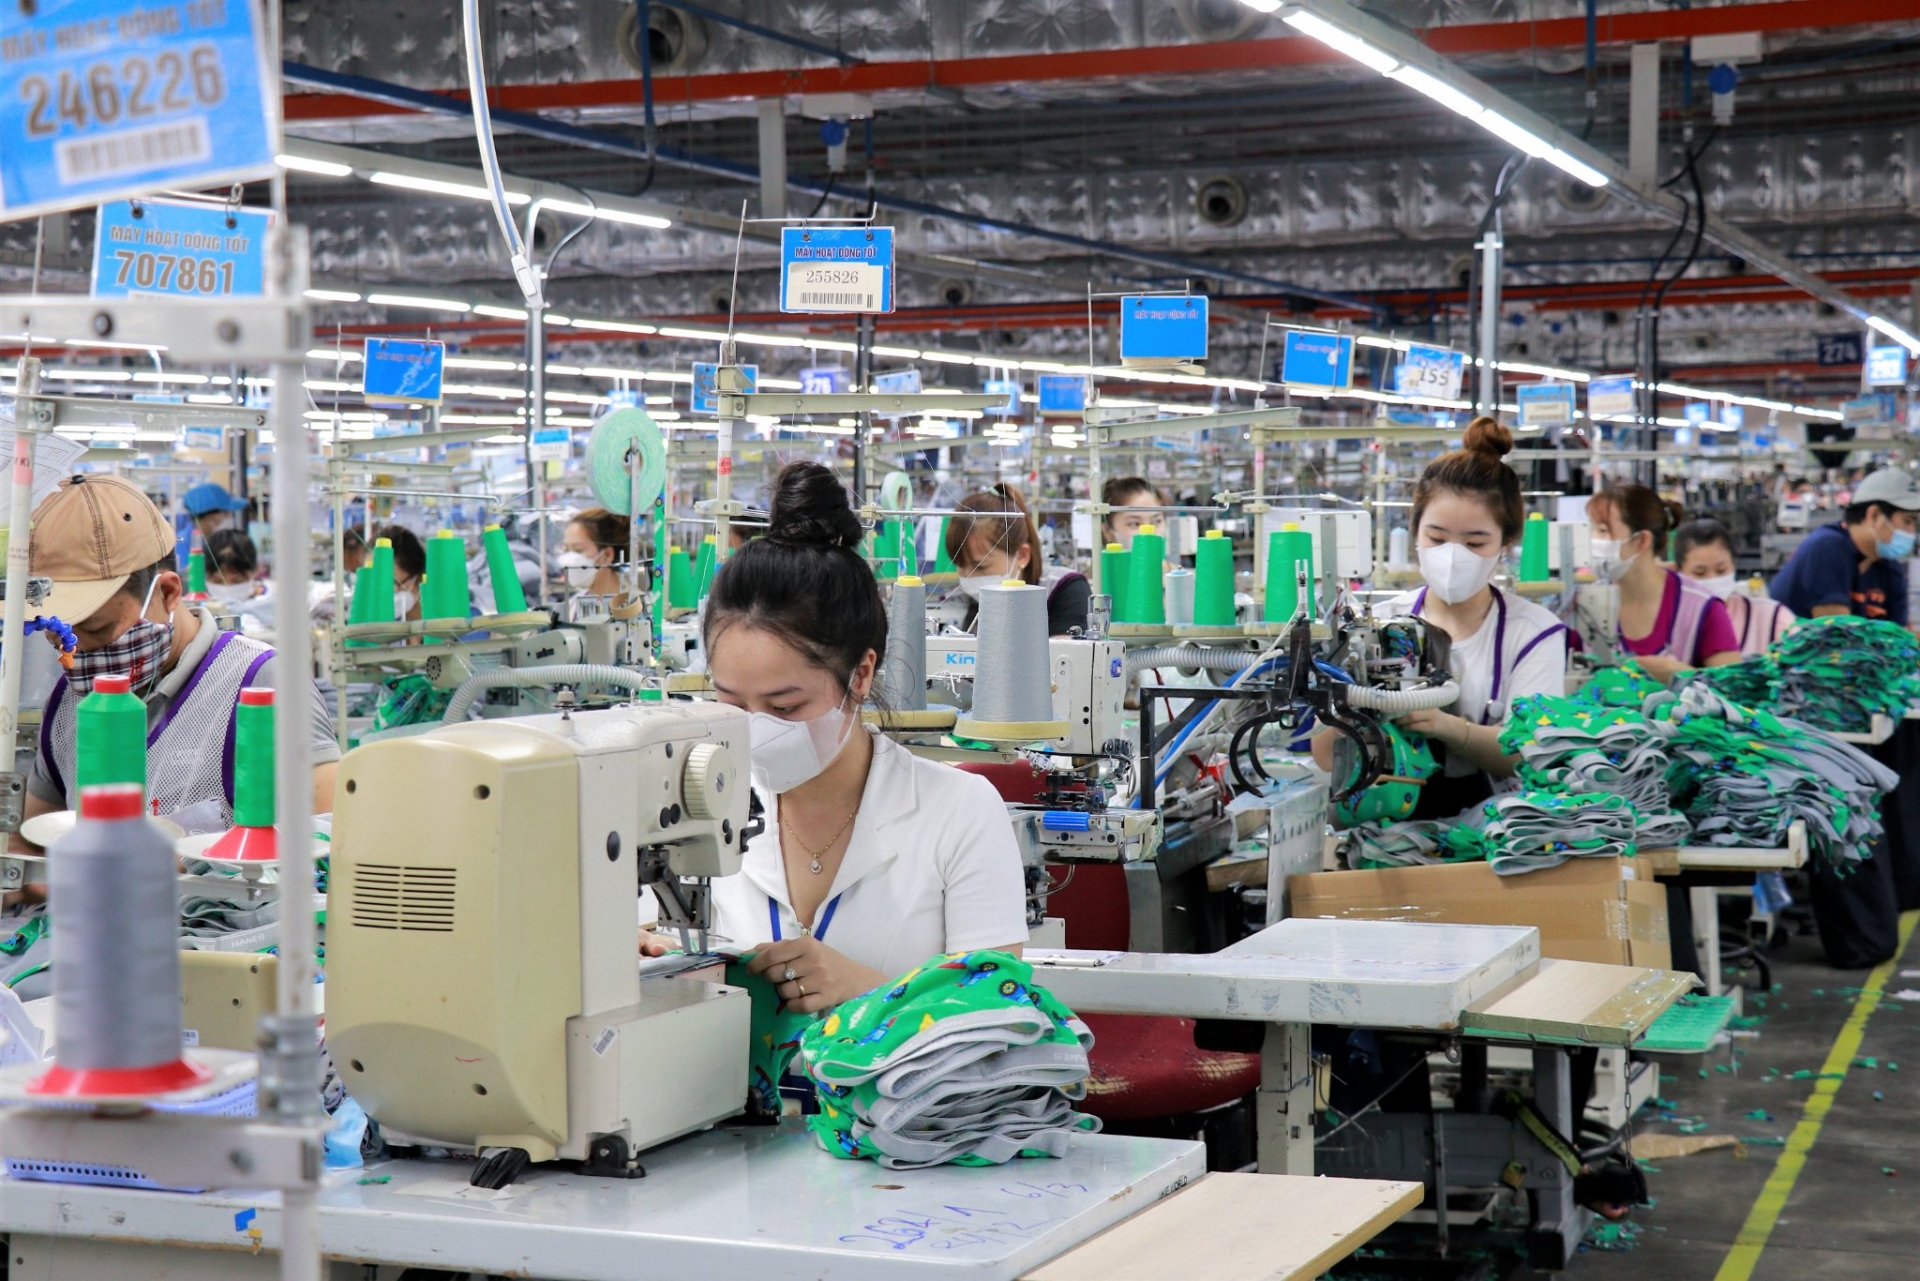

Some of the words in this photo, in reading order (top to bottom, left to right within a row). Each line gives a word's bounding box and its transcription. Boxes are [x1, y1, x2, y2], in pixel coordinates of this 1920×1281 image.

[20, 44, 228, 137] 246226
[110, 225, 141, 243] MÁY
[145, 229, 180, 248] HOẠT
[184, 232, 220, 252] ĐỘNG
[225, 234, 249, 253] TỐT
[795, 245, 813, 258] MÁY
[815, 247, 836, 260] HOẠT
[838, 245, 861, 260] ĐỘNG
[863, 243, 878, 258] TỐT
[115, 250, 235, 295] 707861
[806, 269, 859, 284] 255826
[231, 933, 265, 948] HANES
